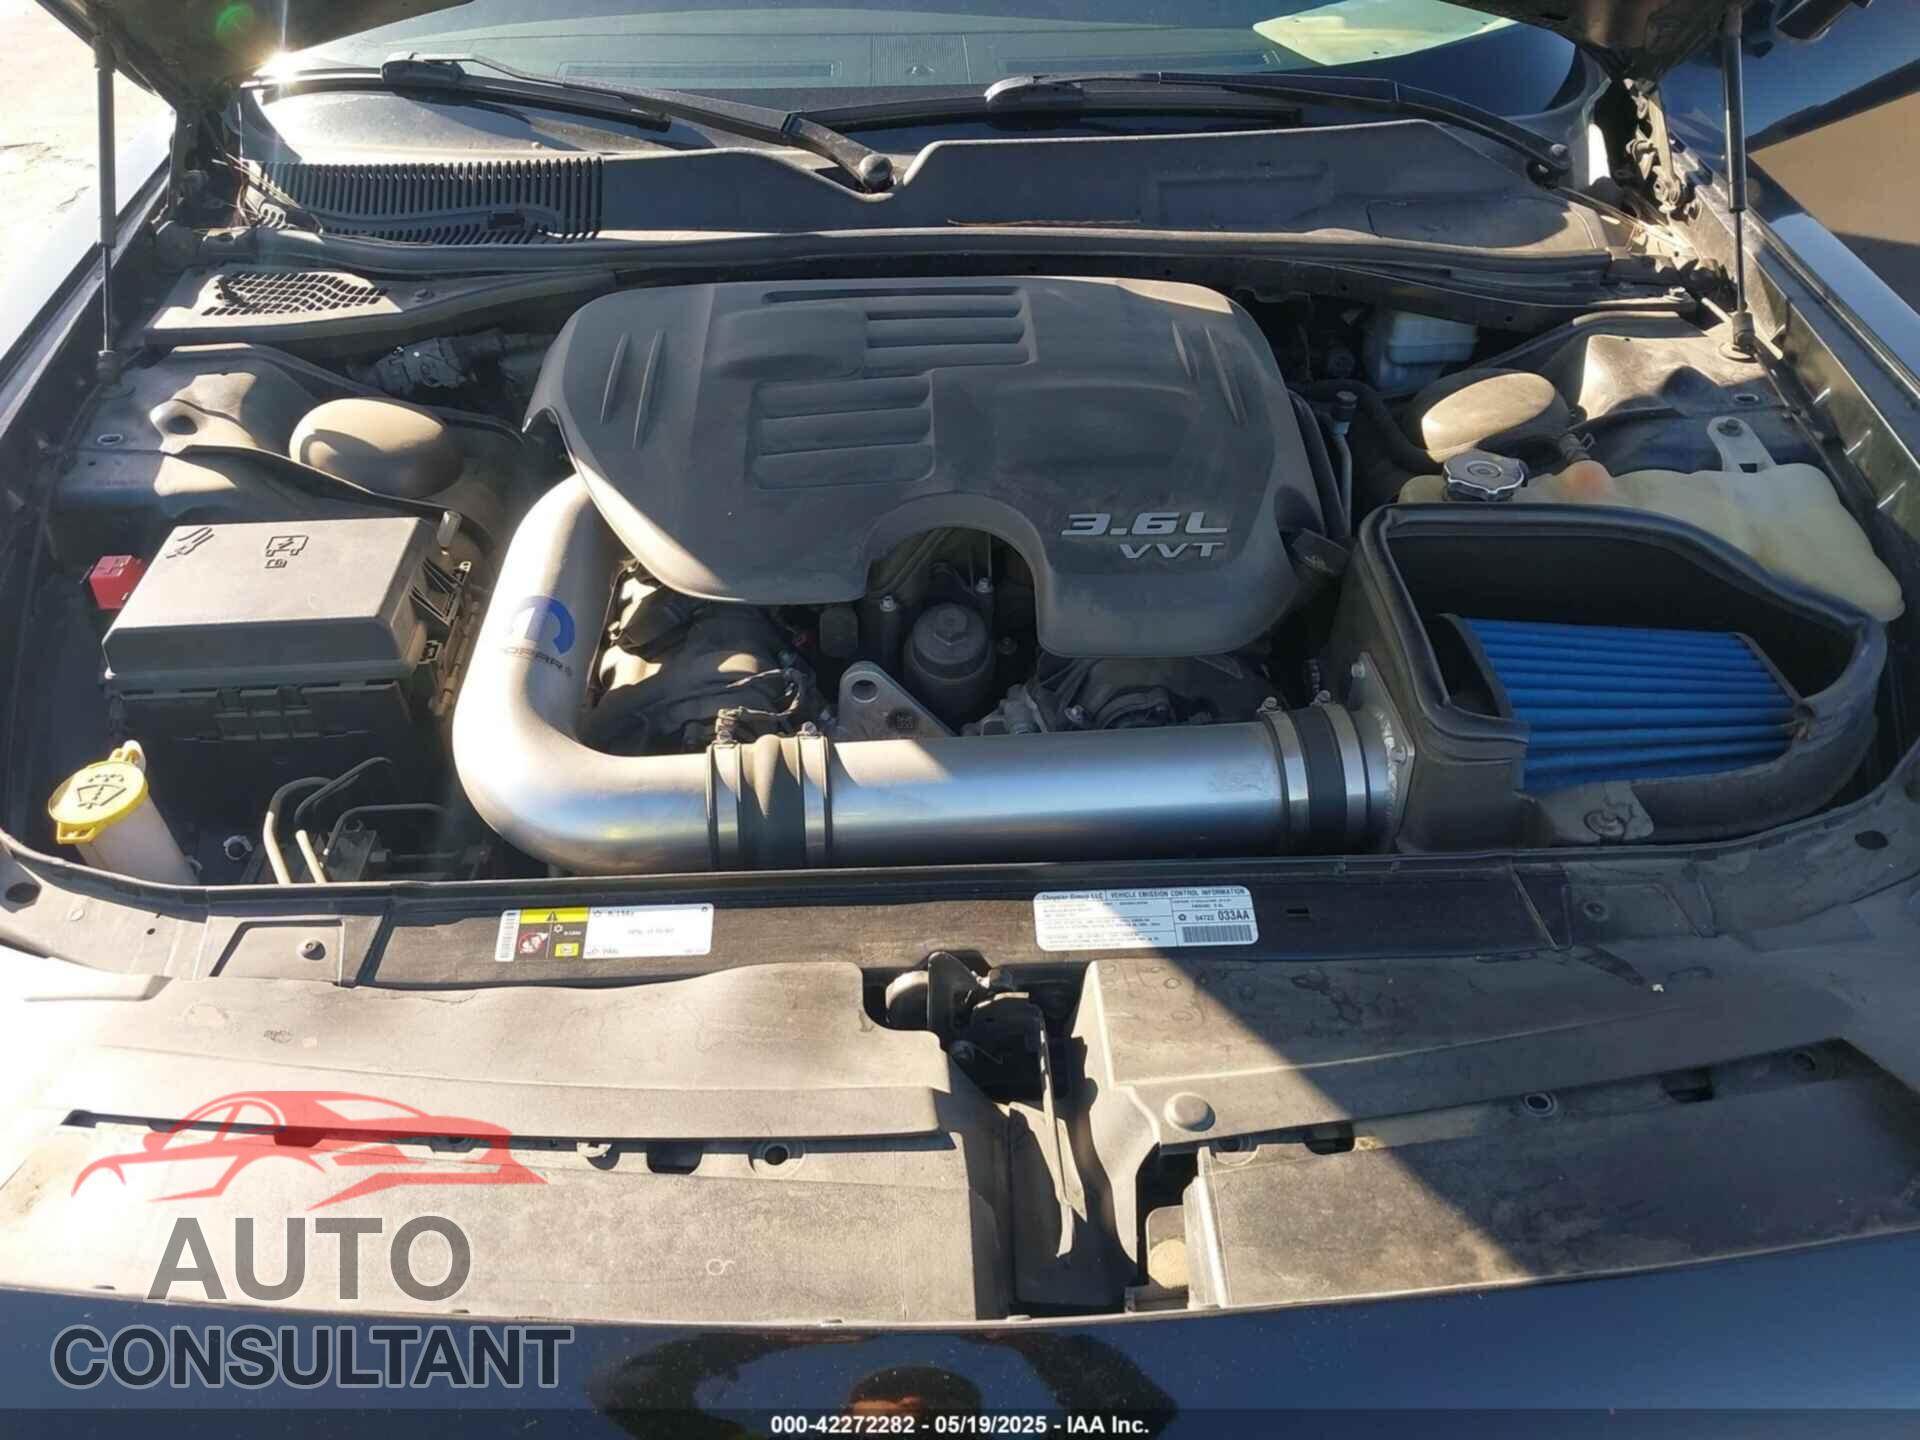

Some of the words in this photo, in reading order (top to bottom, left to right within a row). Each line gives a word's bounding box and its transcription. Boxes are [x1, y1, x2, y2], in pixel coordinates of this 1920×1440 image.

[1061, 511, 1228, 536] 3.6L
[1120, 542, 1225, 559] VVT
[1111, 891, 1136, 899] VEHICLE
[1138, 890, 1169, 898] EMISSION
[1171, 889, 1198, 898] CONTROL
[1200, 888, 1246, 896] INFORMATION
[1218, 909, 1250, 921] 033AA
